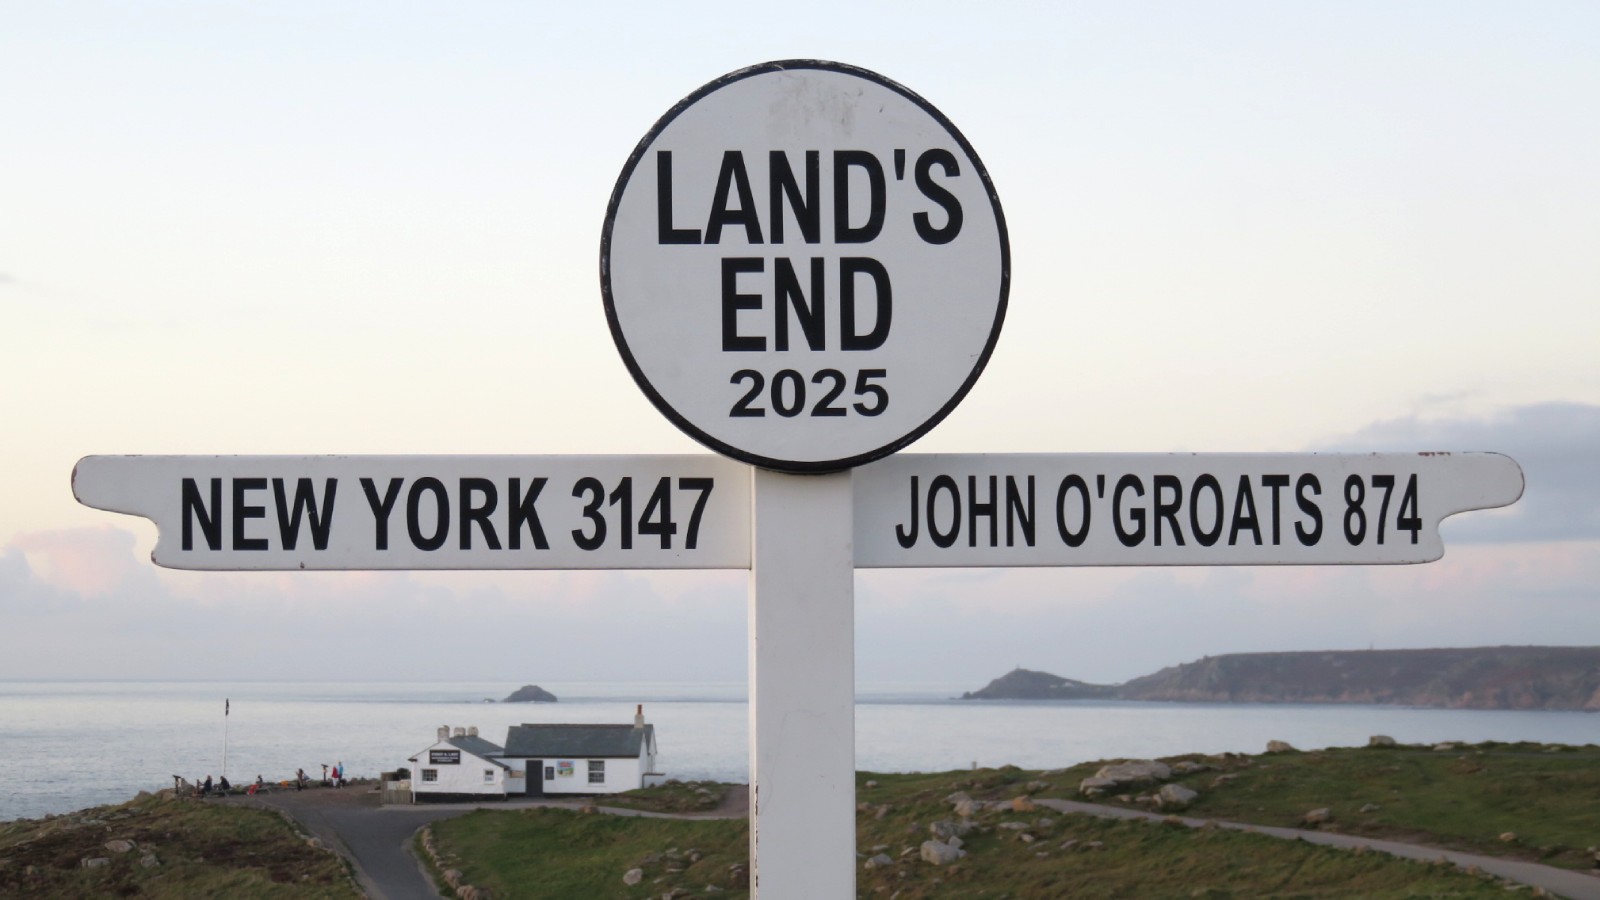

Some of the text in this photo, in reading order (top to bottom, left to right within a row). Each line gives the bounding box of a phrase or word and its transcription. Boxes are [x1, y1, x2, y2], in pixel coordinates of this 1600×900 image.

[657, 149, 964, 245] LAND'S
[721, 256, 893, 352] END
[728, 368, 889, 418] 2025
[181, 476, 714, 552] NEW YORK 3147
[895, 473, 1423, 549] JOHN O'GROATS 874
